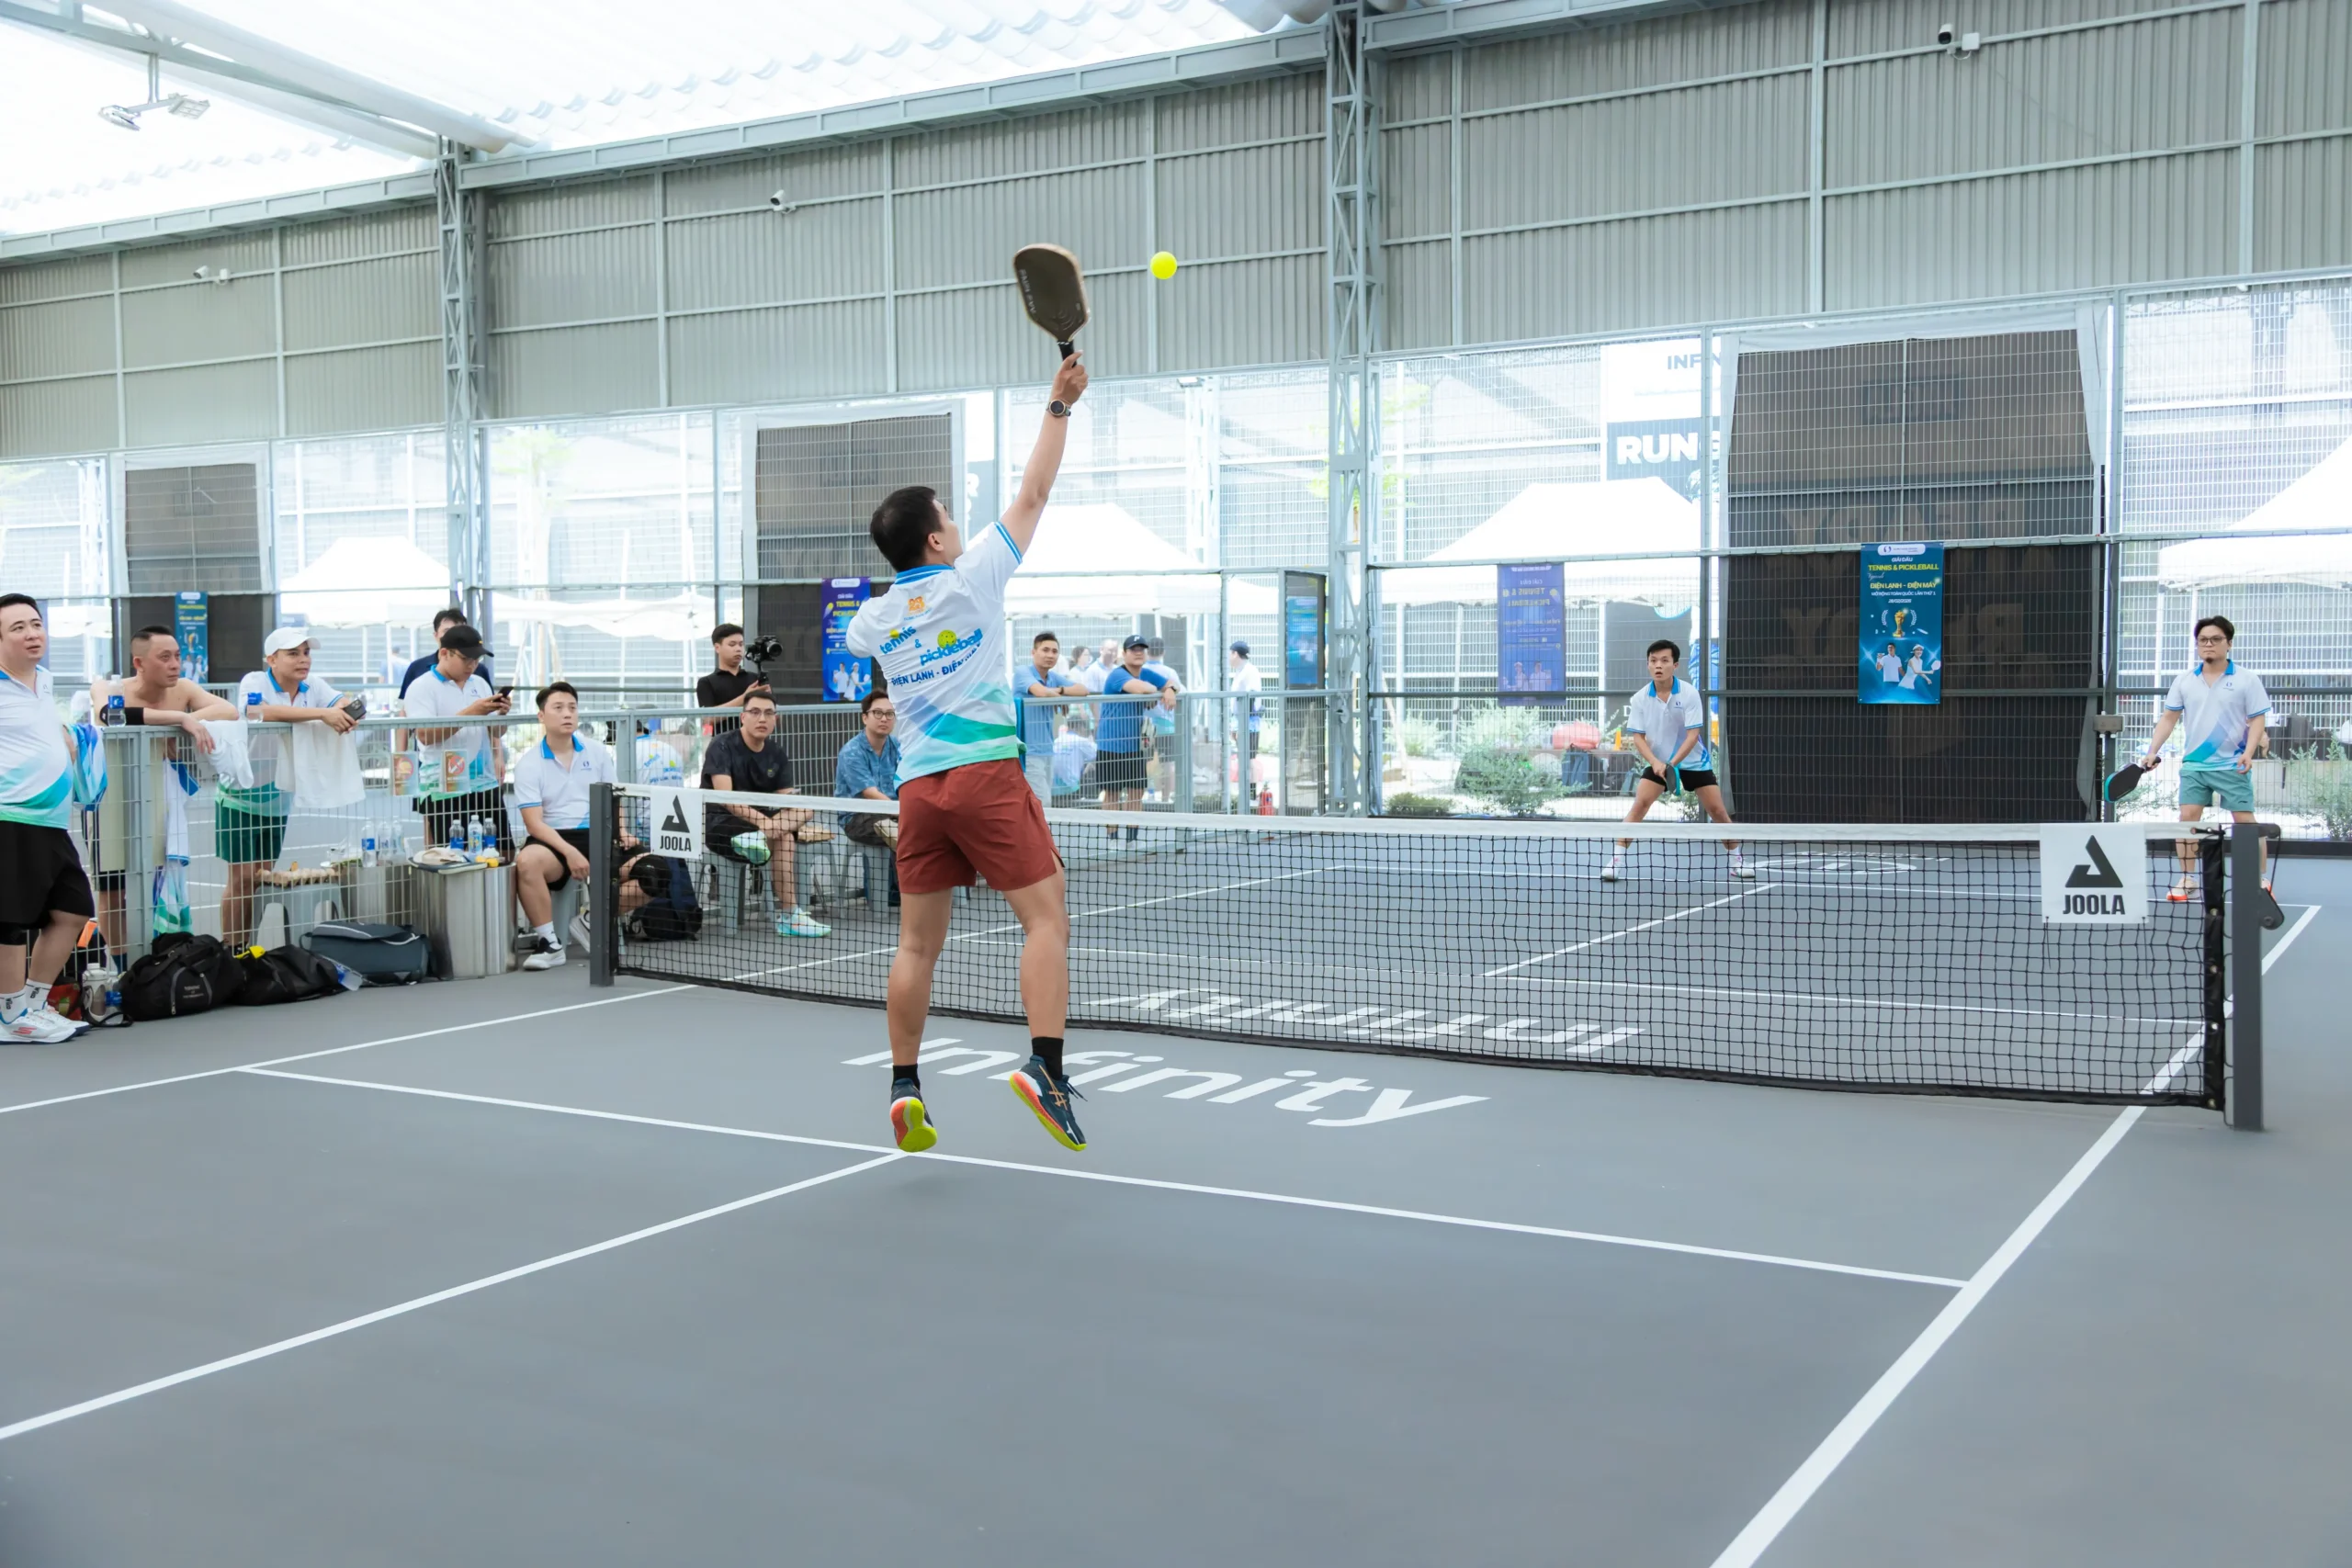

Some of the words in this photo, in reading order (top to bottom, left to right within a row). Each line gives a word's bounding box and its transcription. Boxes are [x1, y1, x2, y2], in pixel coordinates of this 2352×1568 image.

[879, 626, 916, 654] tennis
[914, 638, 922, 649] &
[920, 628, 983, 666] pickleball
[910, 670, 934, 683] LẠNH
[660, 836, 692, 852] JOOLA
[2063, 894, 2126, 915] JOOLA
[840, 1038, 1490, 1128] Infinity
